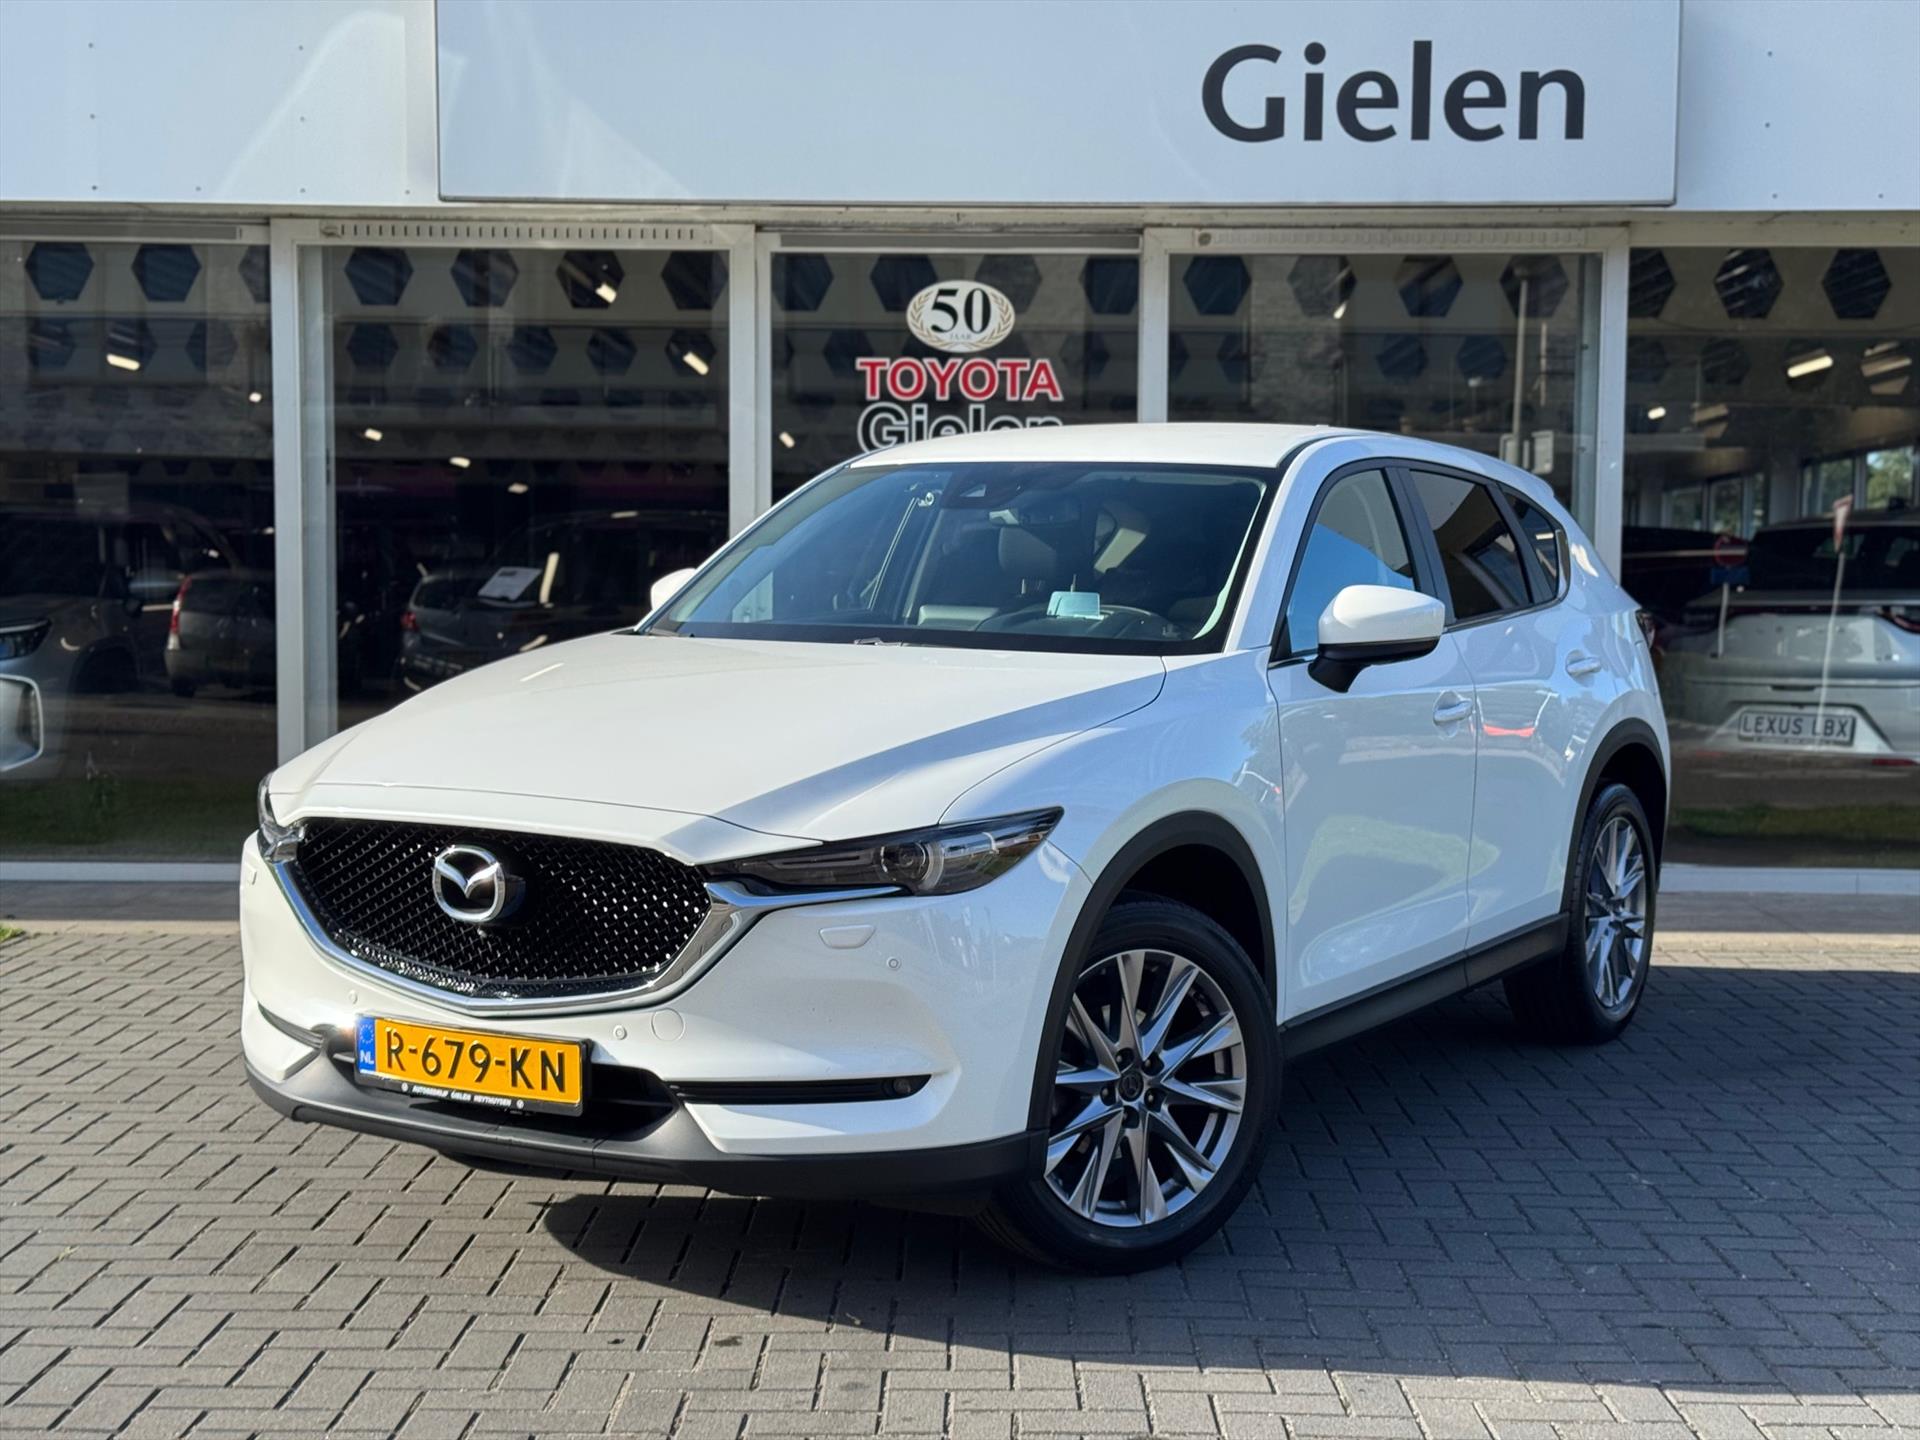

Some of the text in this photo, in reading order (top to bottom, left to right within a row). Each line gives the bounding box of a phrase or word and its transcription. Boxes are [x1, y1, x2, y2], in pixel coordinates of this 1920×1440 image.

[1202, 40, 1585, 142] Gielen
[930, 288, 992, 333] 50
[856, 357, 1064, 401] TOYOTA
[857, 402, 1063, 453] Giel
[1743, 715, 1849, 738] LEXUS LBX
[360, 1050, 374, 1065] NL
[385, 1027, 567, 1093] R-679-KN
